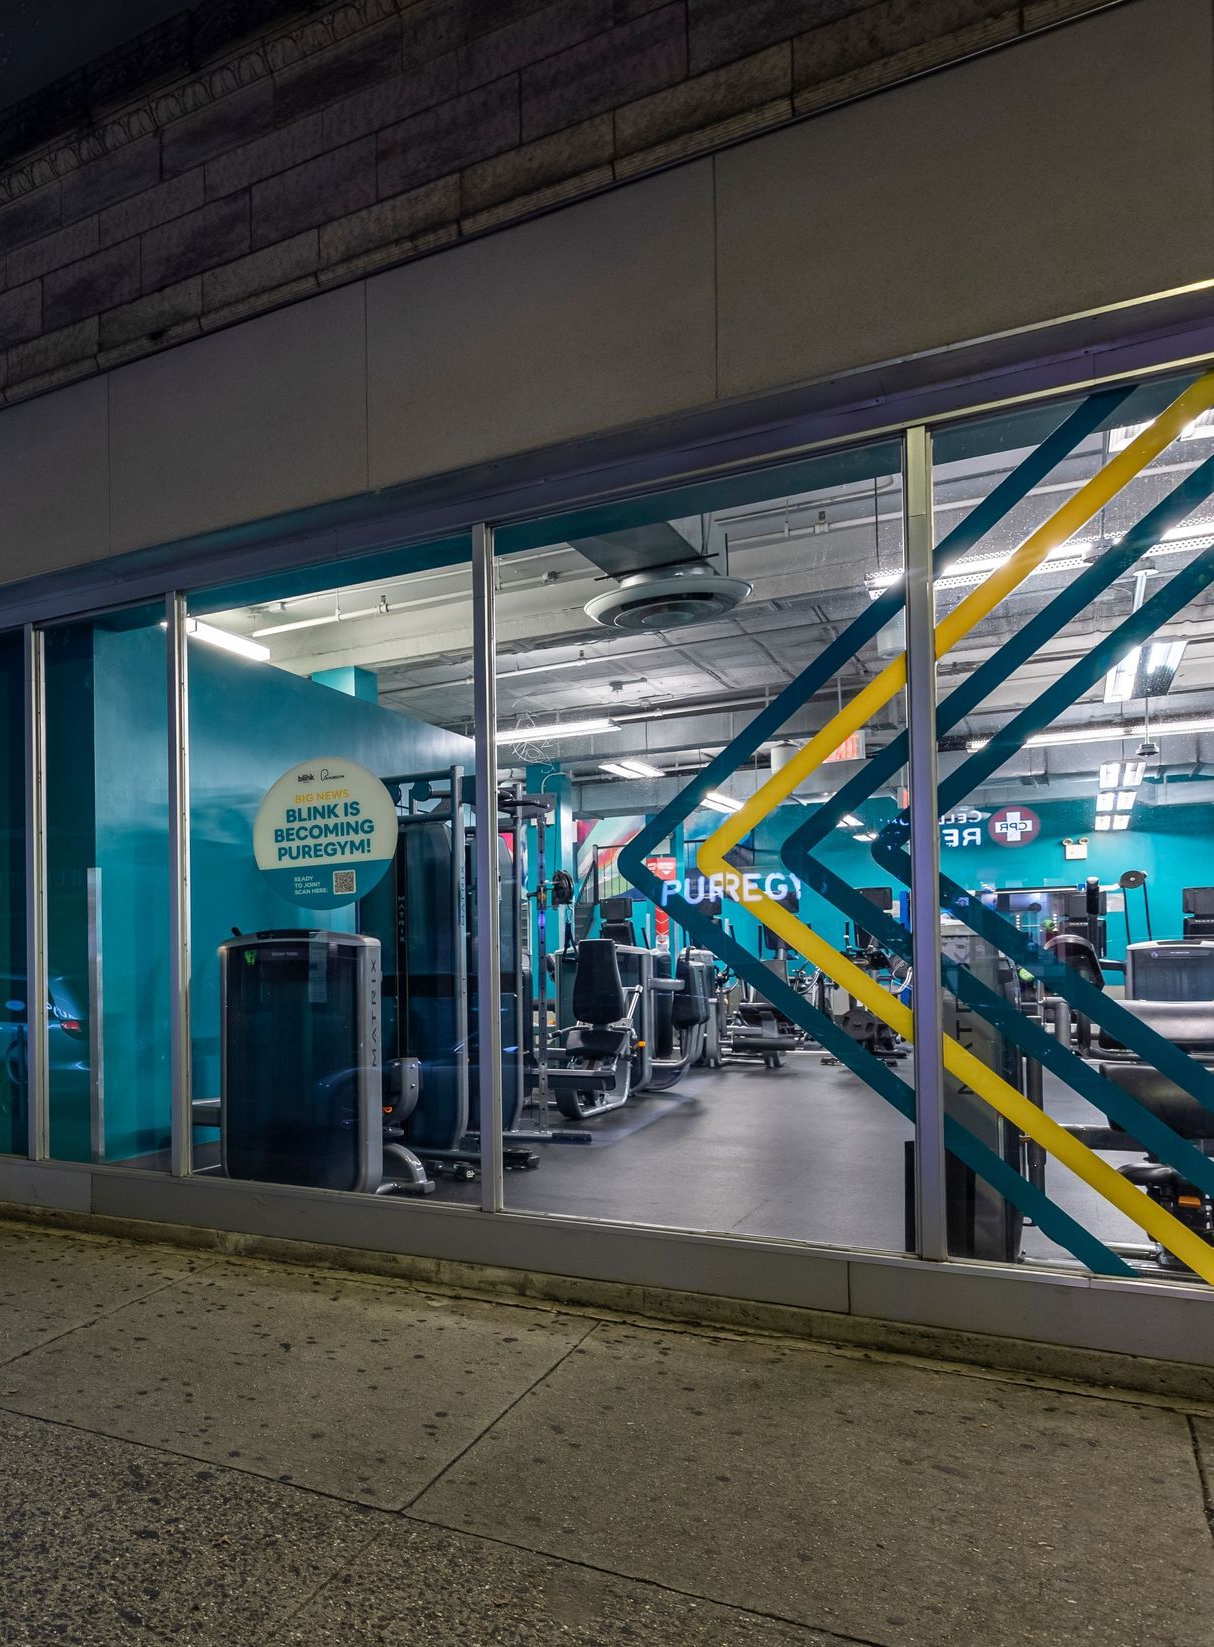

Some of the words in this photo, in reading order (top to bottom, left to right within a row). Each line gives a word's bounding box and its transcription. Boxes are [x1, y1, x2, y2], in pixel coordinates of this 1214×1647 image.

[295, 794, 314, 803] BIG
[317, 789, 349, 800] NEWS
[286, 804, 339, 823] BLINK
[344, 801, 360, 817] IS
[274, 819, 374, 843] BECOMING
[277, 839, 371, 861] PUREGYM!
[397, 896, 406, 942] MATRIX
